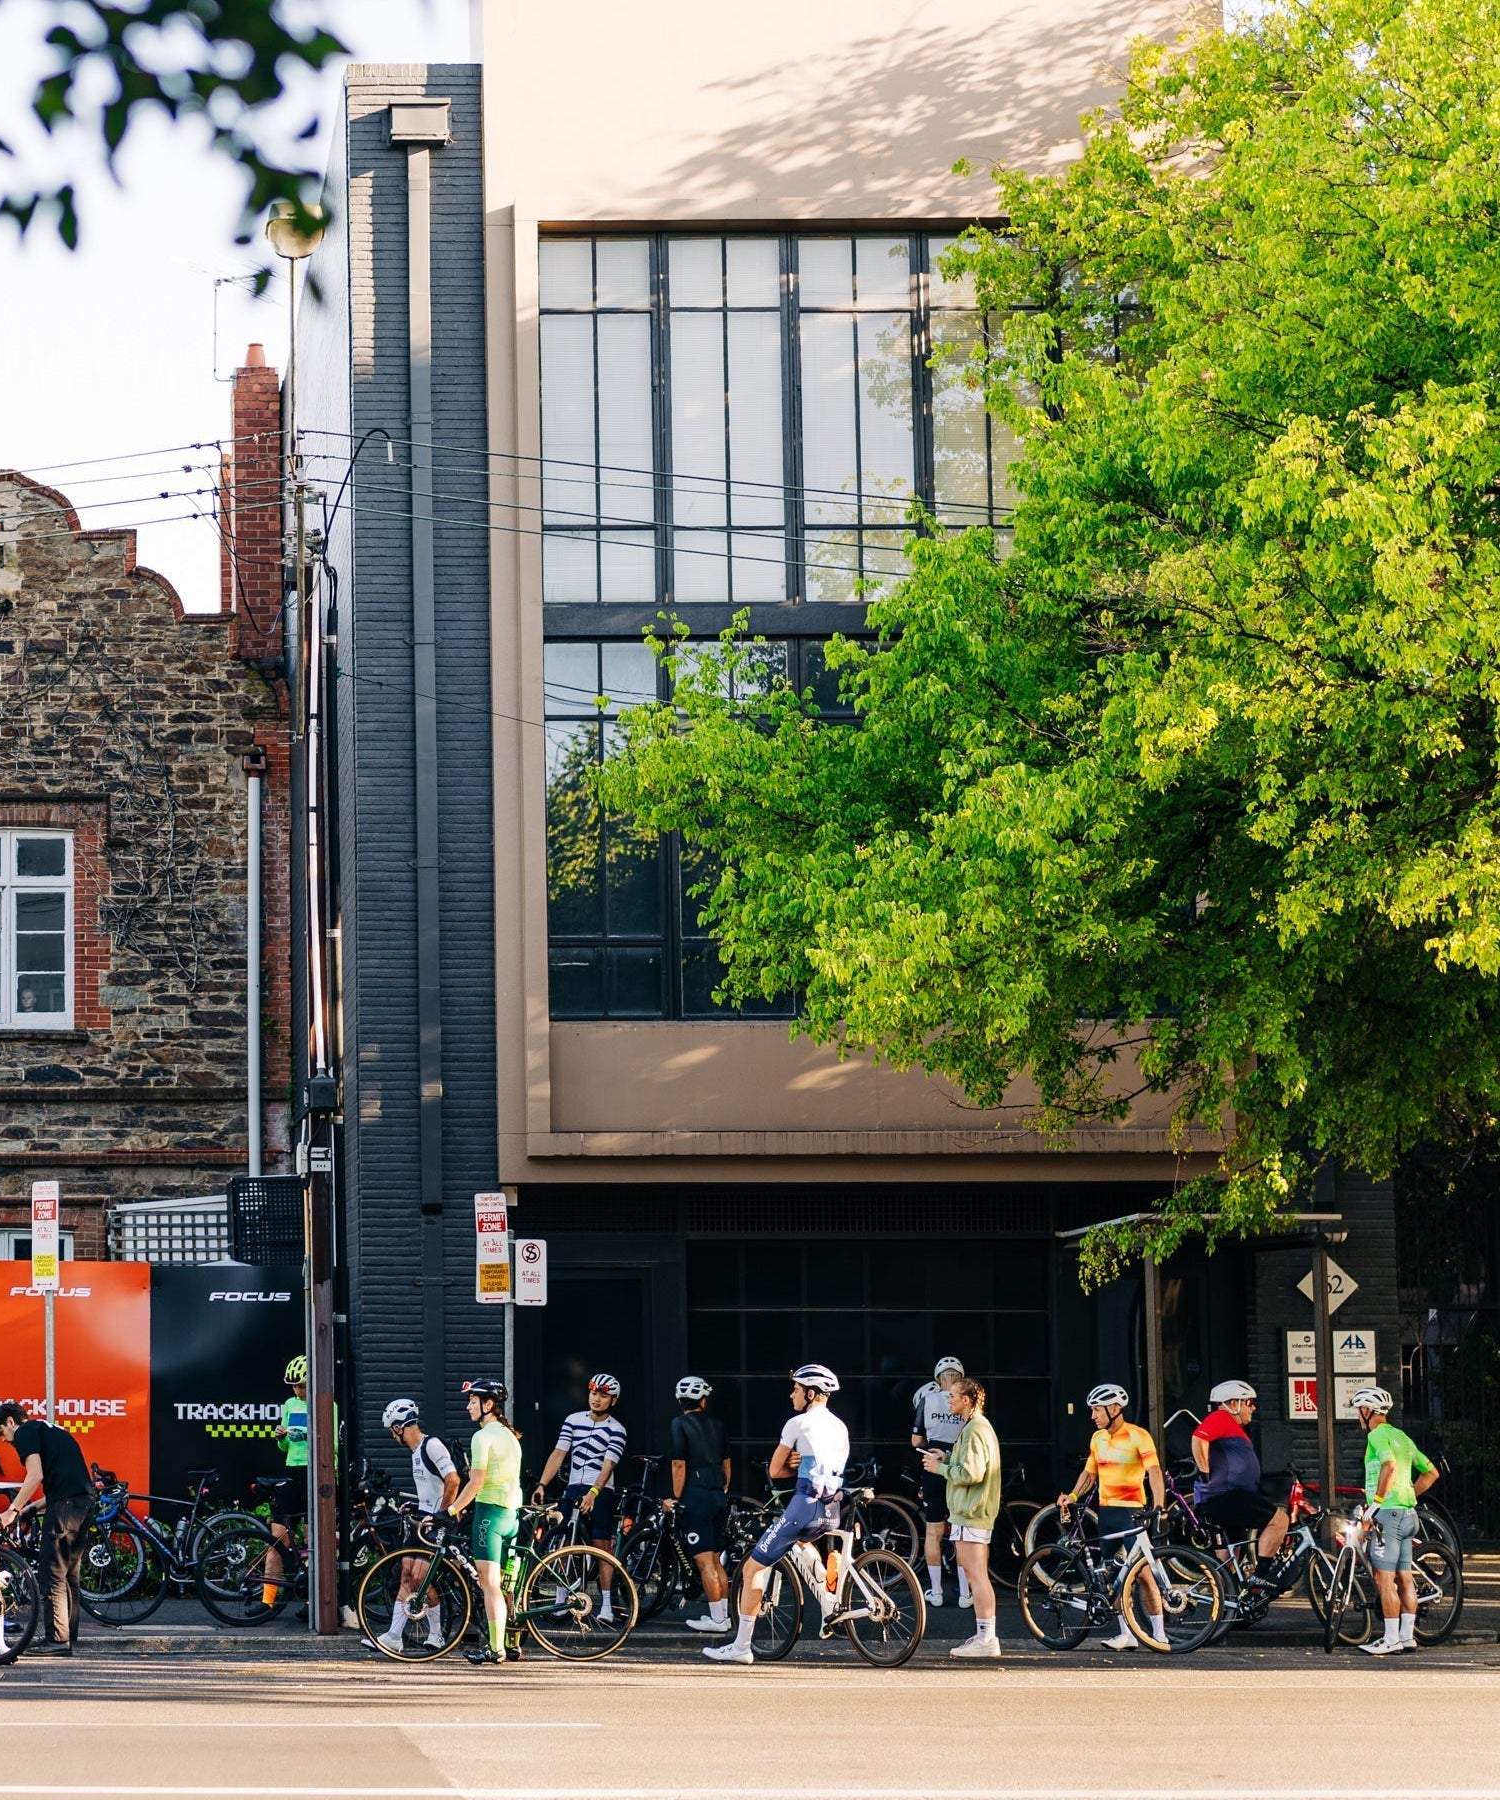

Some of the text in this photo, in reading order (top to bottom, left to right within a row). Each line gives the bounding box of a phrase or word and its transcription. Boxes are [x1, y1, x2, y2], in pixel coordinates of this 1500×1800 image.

[36, 1201, 54, 1210] PERMIT
[37, 1211, 52, 1219] ZONE
[478, 1212, 504, 1222] PERMIT
[482, 1223, 502, 1232] ZONE
[209, 1292, 291, 1302] FOCUS
[174, 1403, 282, 1420] TRACKHO
